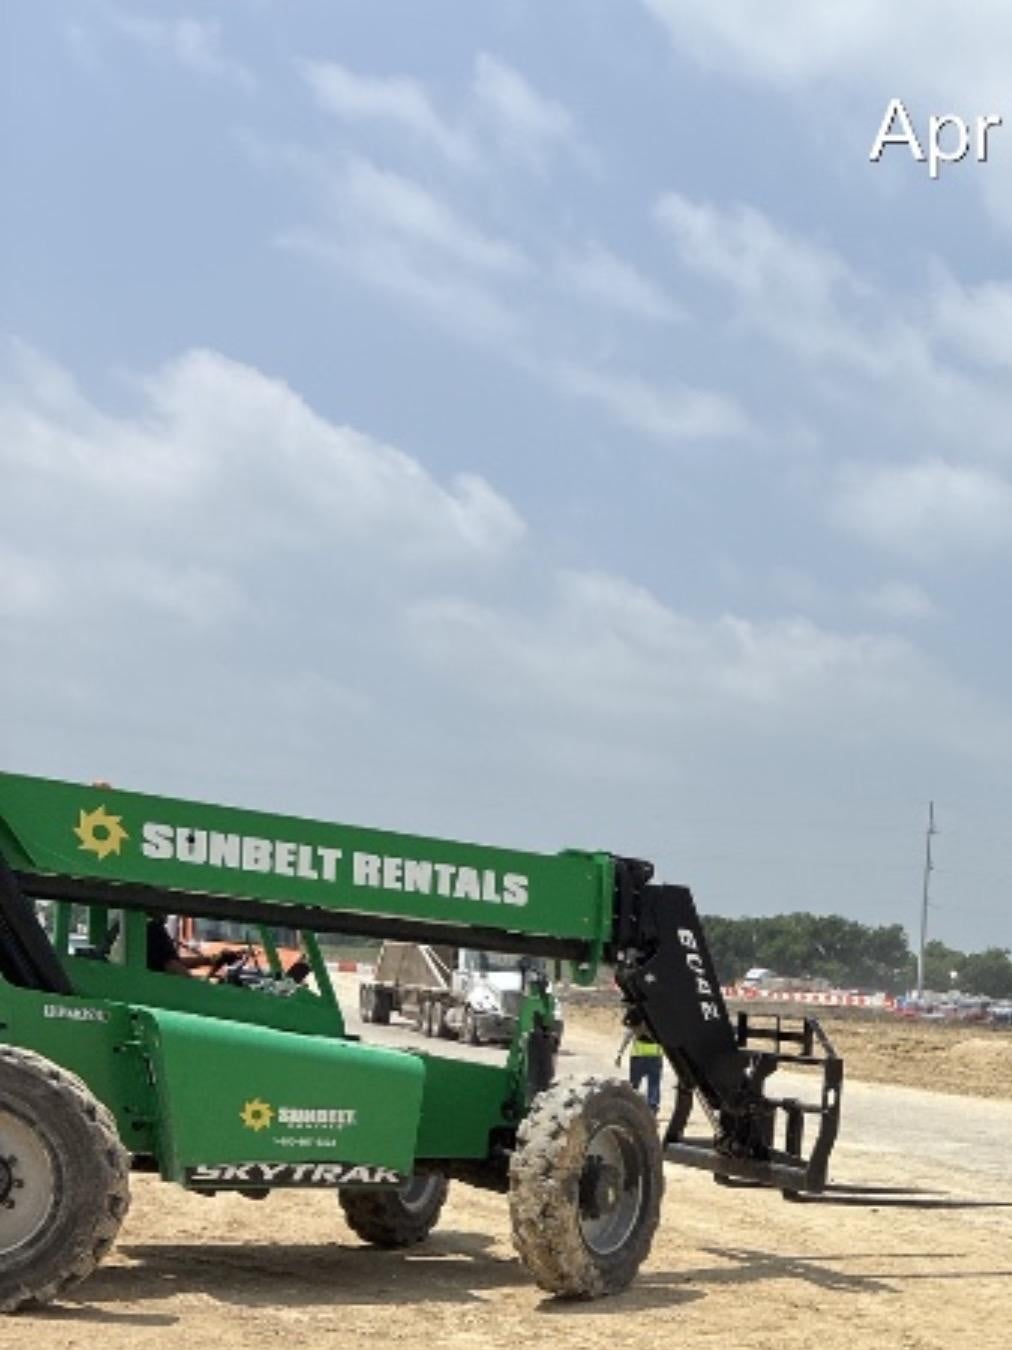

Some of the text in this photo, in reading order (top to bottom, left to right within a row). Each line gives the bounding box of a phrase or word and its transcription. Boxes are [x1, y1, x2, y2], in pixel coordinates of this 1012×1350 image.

[141, 821, 529, 906] SUNBELT RENTALS
[191, 1161, 400, 1183] SKYTRAK
